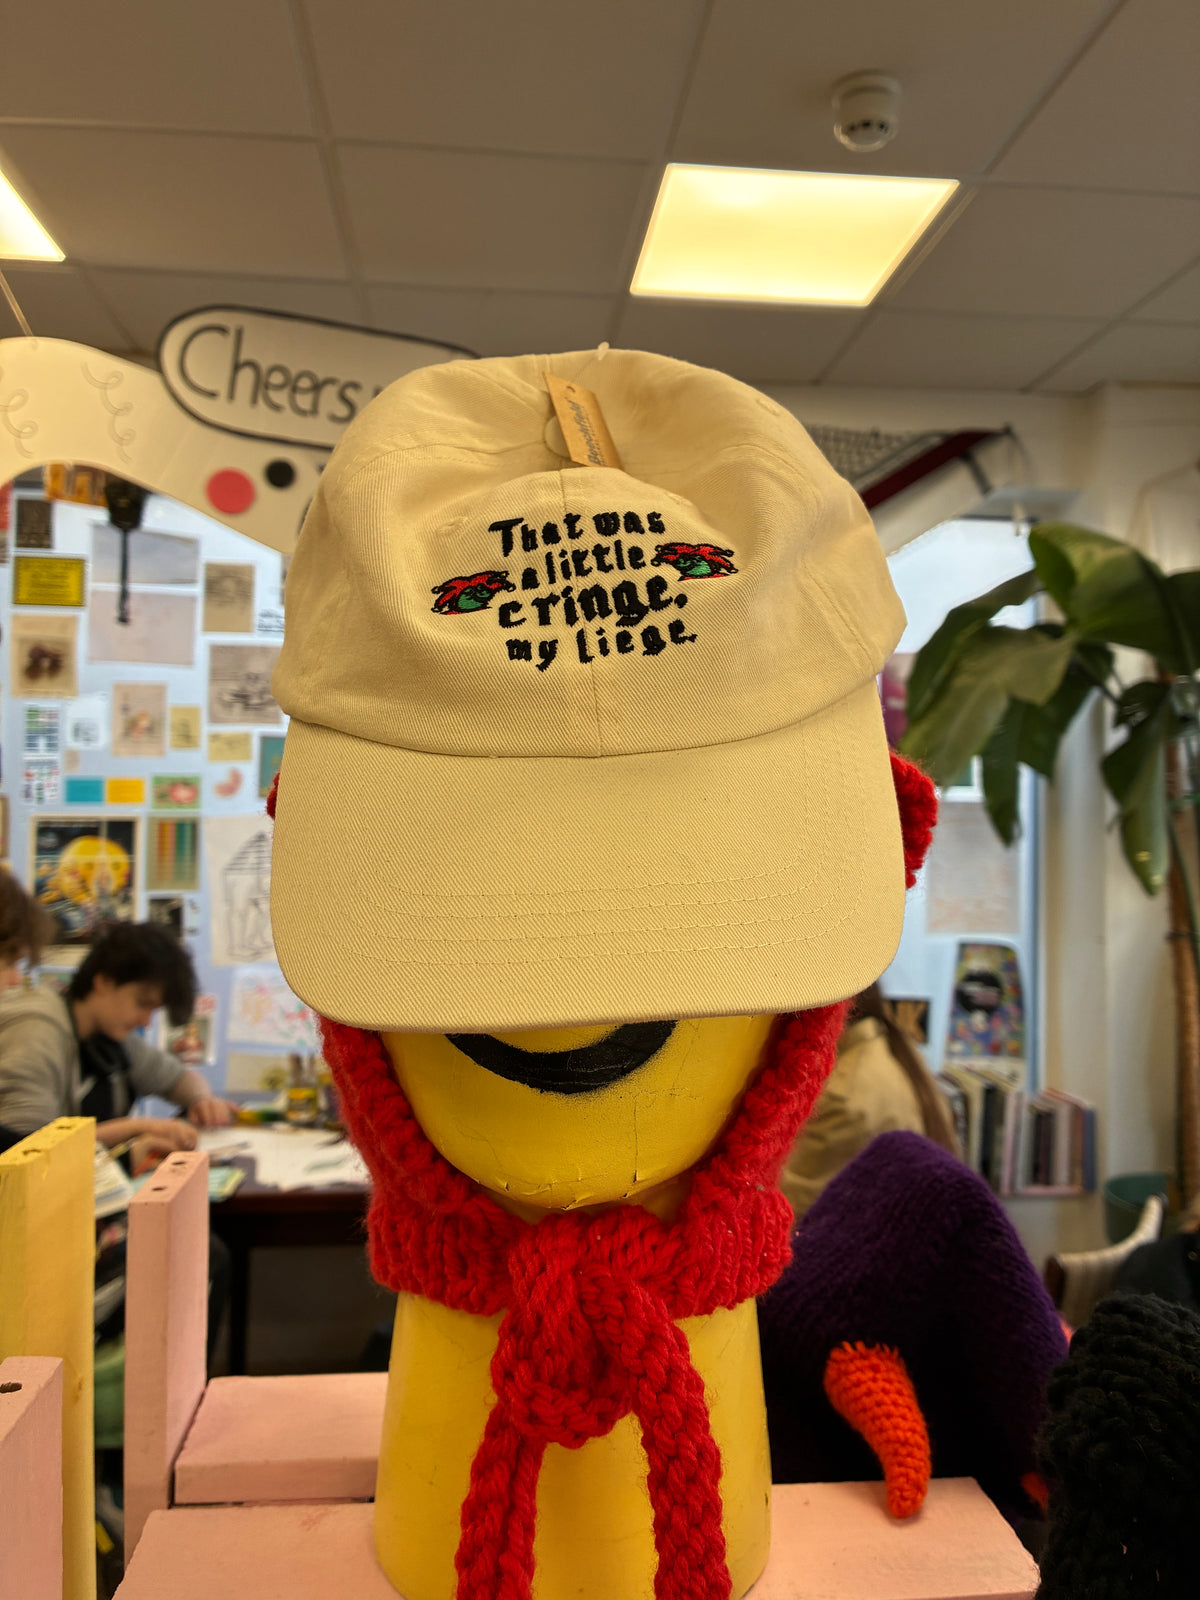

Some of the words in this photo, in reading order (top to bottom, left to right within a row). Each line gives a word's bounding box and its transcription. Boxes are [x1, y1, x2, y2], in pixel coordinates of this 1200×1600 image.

[180, 325, 362, 424] Cheers
[488, 512, 584, 557] That
[592, 511, 666, 537] was
[521, 567, 540, 591] a
[545, 539, 646, 585] little
[498, 575, 688, 628] cringe.
[505, 638, 558, 672] my
